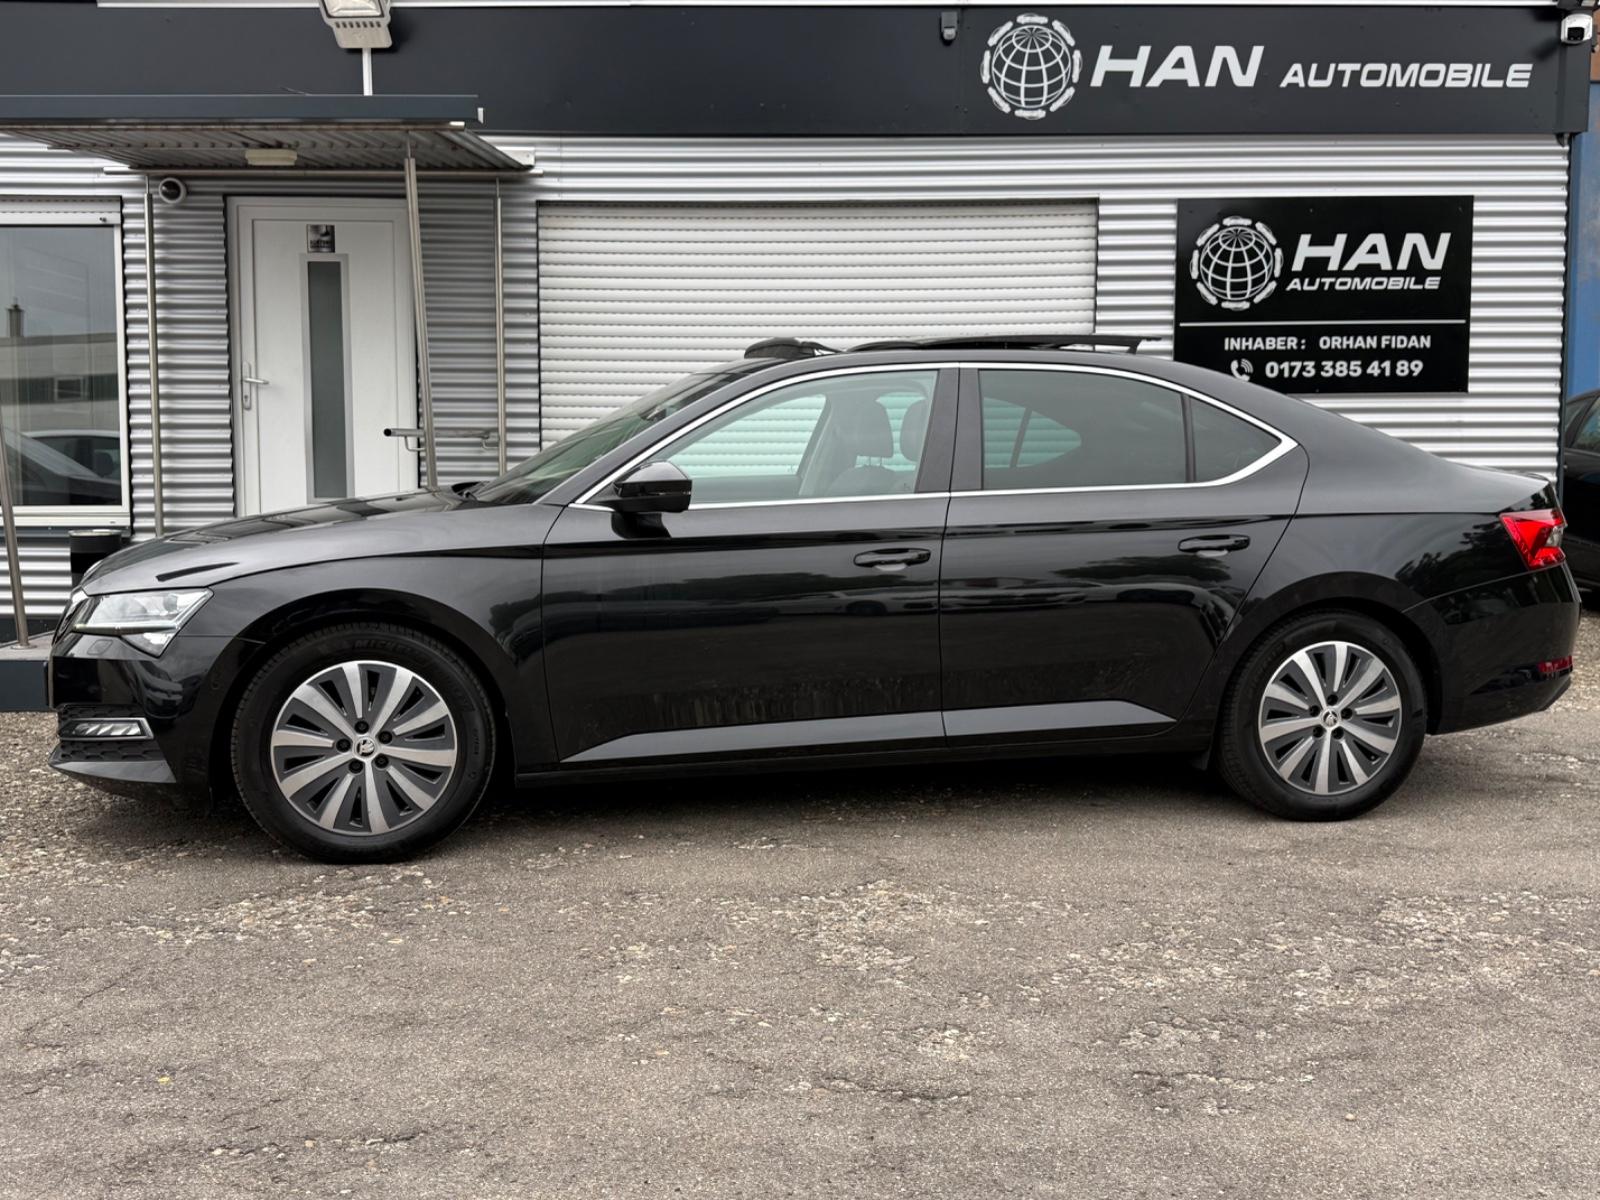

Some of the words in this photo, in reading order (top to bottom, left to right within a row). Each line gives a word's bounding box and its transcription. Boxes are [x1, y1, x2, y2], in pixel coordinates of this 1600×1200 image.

[1090, 45, 1265, 88] HAN
[1280, 63, 1534, 89] AUTOMOBILE
[1292, 232, 1452, 272] HAN
[1286, 276, 1442, 291] AUTOMOBILE
[1319, 335, 1378, 350] ORHAN
[1381, 335, 1431, 349] FIDAN
[1265, 361, 1316, 378] 0173
[1320, 361, 1362, 377] 385
